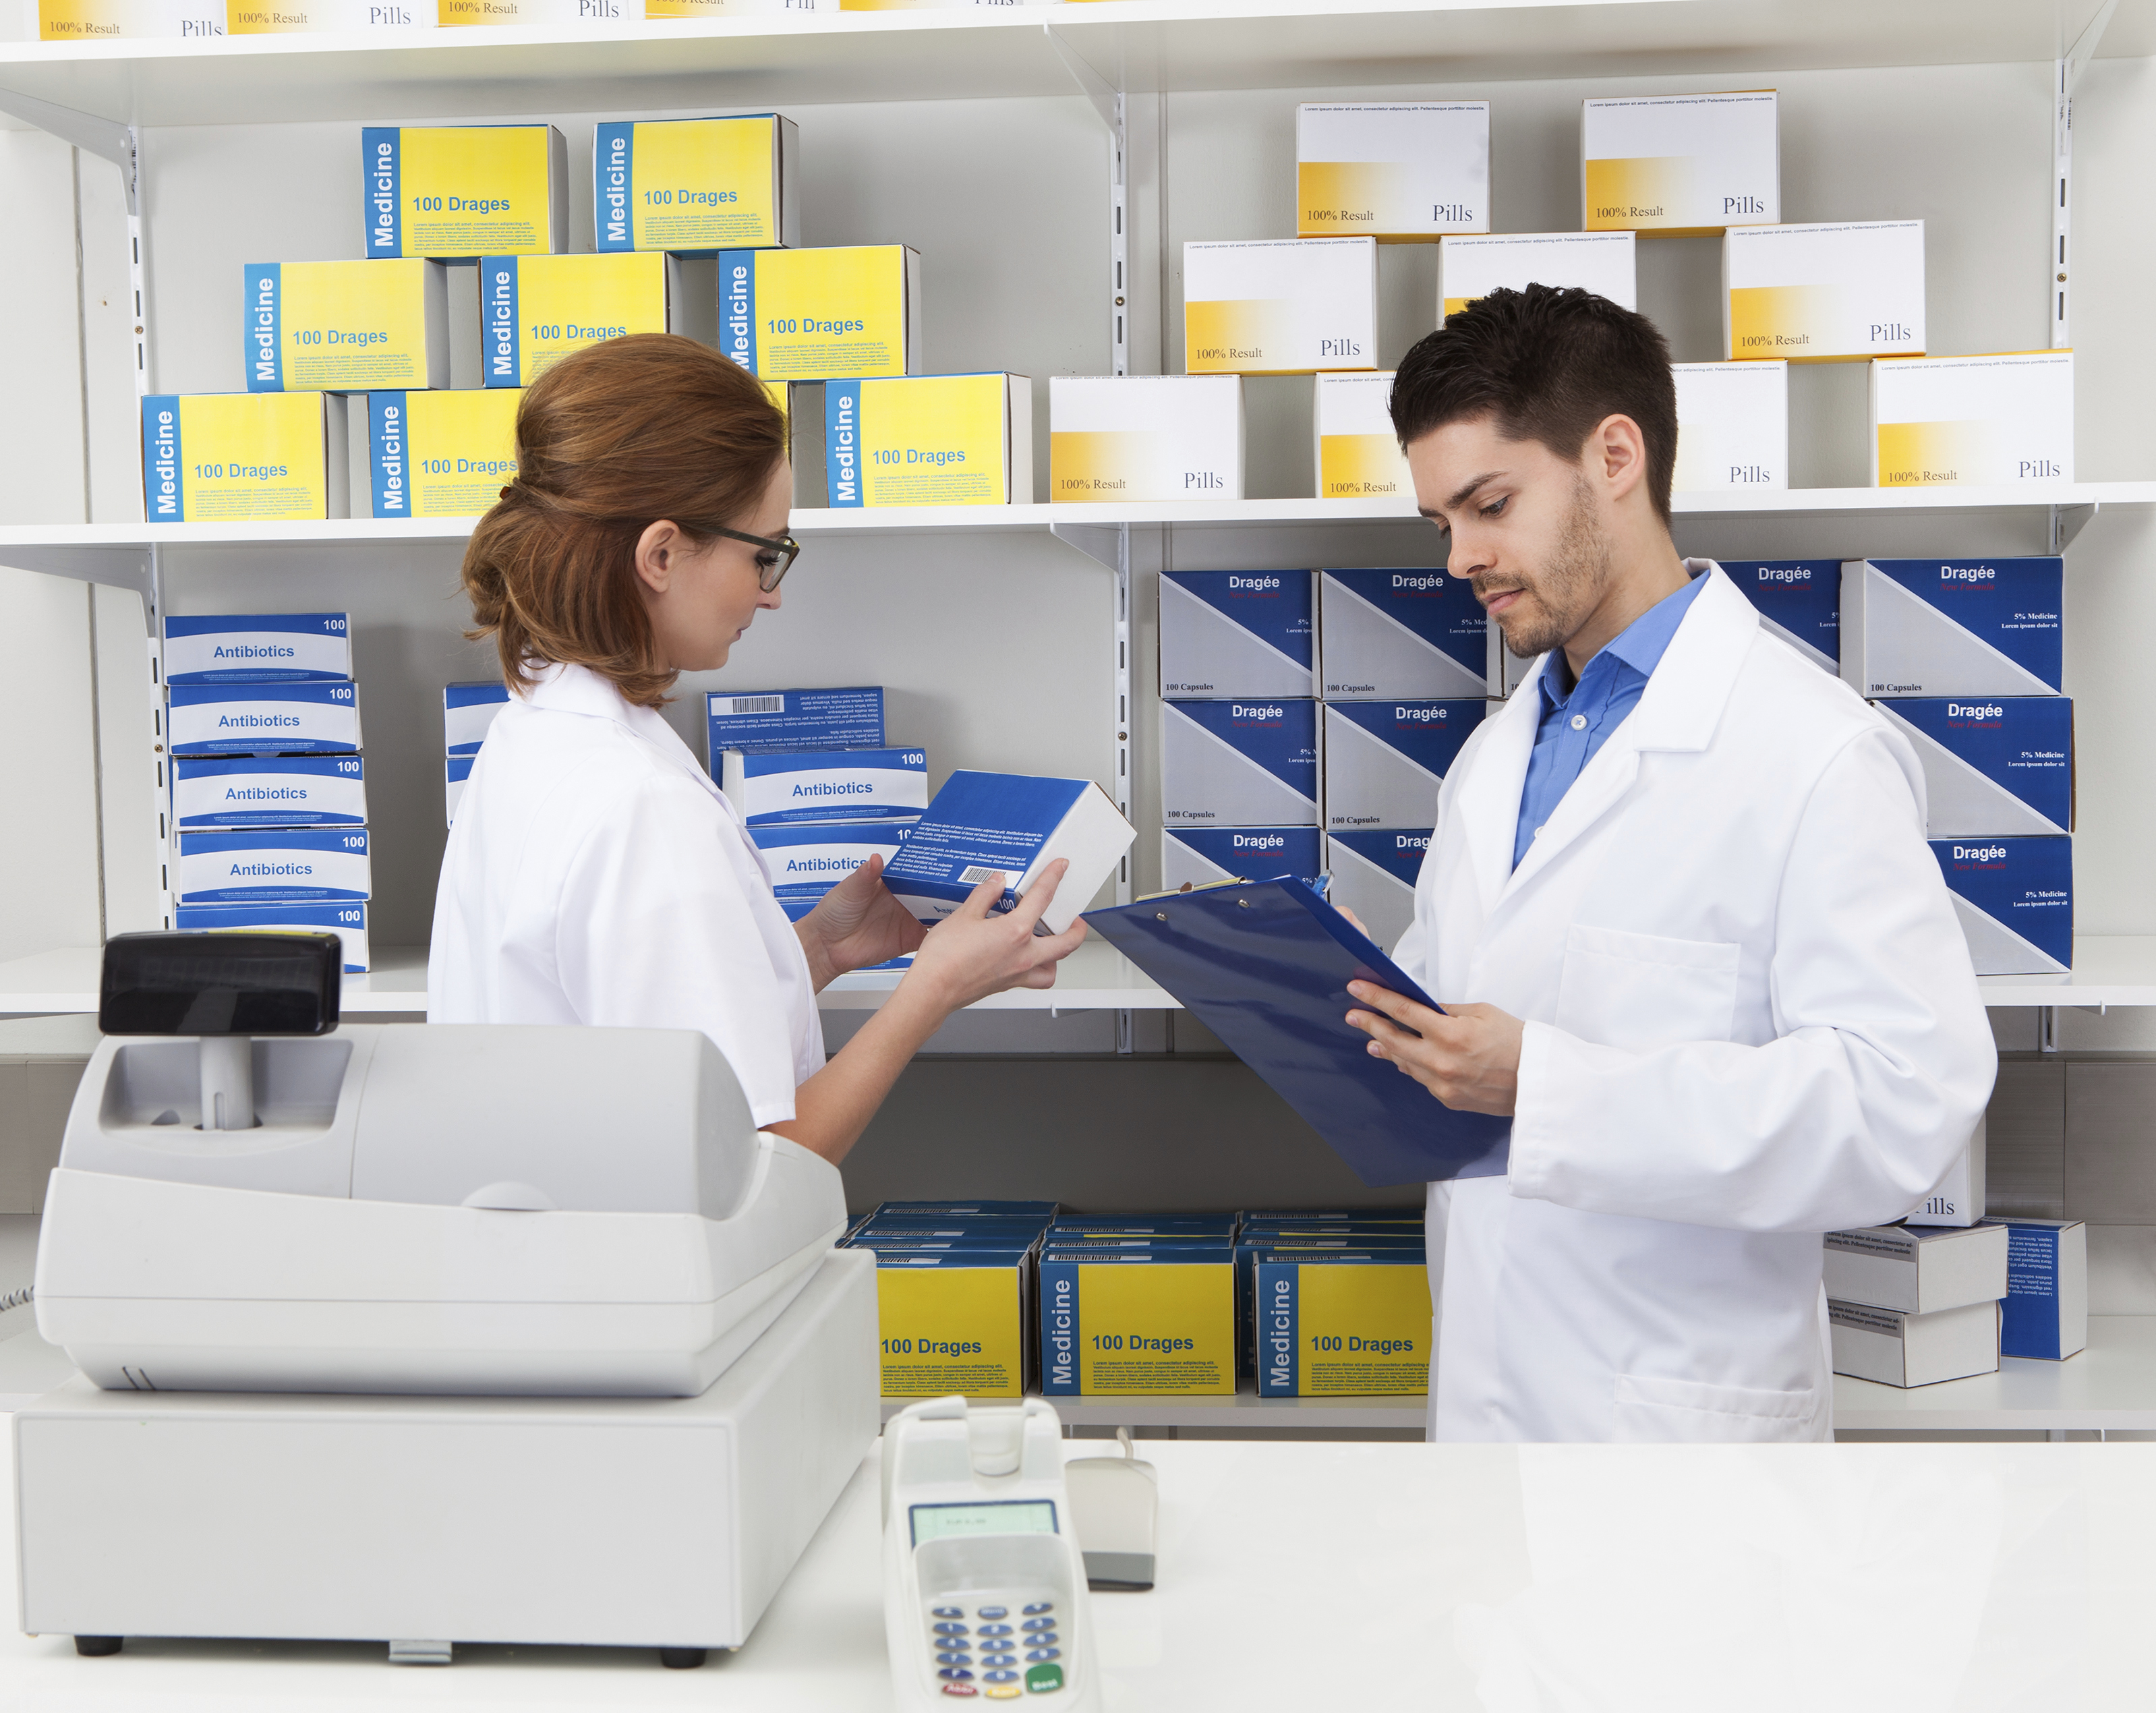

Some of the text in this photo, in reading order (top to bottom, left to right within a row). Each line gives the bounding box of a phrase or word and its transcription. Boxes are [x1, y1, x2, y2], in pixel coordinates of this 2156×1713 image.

[448, 1, 517, 14] 100% Result
[578, 0, 620, 19] Pills
[238, 13, 308, 24] 100% Result
[368, 6, 411, 26] Pills
[51, 22, 120, 34] 100% Result
[181, 20, 223, 37] Pills
[374, 143, 394, 247] Medicine
[607, 138, 627, 241] Medicine
[413, 197, 510, 214] 100 Drages
[644, 190, 737, 207] 100 Drages
[1723, 196, 1764, 214] Pills
[1308, 210, 1374, 221] 100% Result
[1432, 204, 1474, 222] Pills
[1597, 206, 1663, 218] 100% Result
[492, 271, 513, 376] Medicine
[729, 266, 750, 370] Medicine
[255, 278, 276, 381] Medicine
[531, 324, 627, 342] 100 Drages
[768, 318, 864, 335] 100 Drages
[1870, 324, 1911, 343] Pills
[293, 330, 388, 347] 100 Drages
[1742, 334, 1809, 347] 100% Result
[1197, 347, 1262, 359] 100% Result
[1320, 339, 1361, 357] Pills
[836, 396, 856, 502] Medicine
[156, 411, 177, 514] Medicine
[382, 406, 403, 510] Medicine
[873, 449, 966, 466] 100 Drages
[194, 463, 288, 480] 100 Drages
[421, 459, 519, 476] 100 Drages
[1730, 465, 1771, 484] Pills
[2018, 461, 2062, 479] Pills
[1061, 479, 1126, 489] 100% Result
[1184, 472, 1224, 489] Pills
[1890, 470, 1957, 482] 100% Result
[1331, 482, 1396, 492] 100% Result
[1758, 567, 1812, 583] Dragée
[1941, 565, 1995, 582] Dragée
[1229, 576, 1281, 591] Dragée
[1392, 575, 1444, 590] Dragée
[323, 619, 346, 631] 100
[214, 645, 295, 658] Antibiotics
[329, 689, 352, 700] 100
[1180, 683, 1213, 692] Capsules
[1341, 685, 1375, 693] Capsules
[1886, 684, 1922, 693] Capsules
[1232, 705, 1283, 720] Dragée
[1396, 707, 1448, 722] Dragée
[1948, 703, 2004, 720] Dragée
[218, 715, 301, 728] Antibiotics
[337, 761, 359, 773] 100
[902, 753, 924, 765] 100
[225, 788, 308, 801] Antibiotics
[792, 782, 873, 797] Antibiotics
[1182, 811, 1215, 819] Capsules
[1347, 816, 1380, 825] Capsules
[343, 836, 366, 848] 100
[1233, 834, 1285, 850] Dragée
[1397, 836, 1431, 849] Drag
[1954, 845, 2007, 862] Dragée
[230, 863, 313, 876] Antibiotics
[786, 857, 869, 872] Antibiotics
[997, 899, 1016, 911] 100
[338, 910, 361, 922] 100
[1916, 1197, 1956, 1215] ills
[1052, 1280, 1072, 1385] Medicine
[1271, 1280, 1290, 1387] Medicine
[881, 1339, 983, 1358] 100 Drages
[1092, 1335, 1194, 1354] 100 Drages
[1311, 1336, 1414, 1355] 100 Drages
